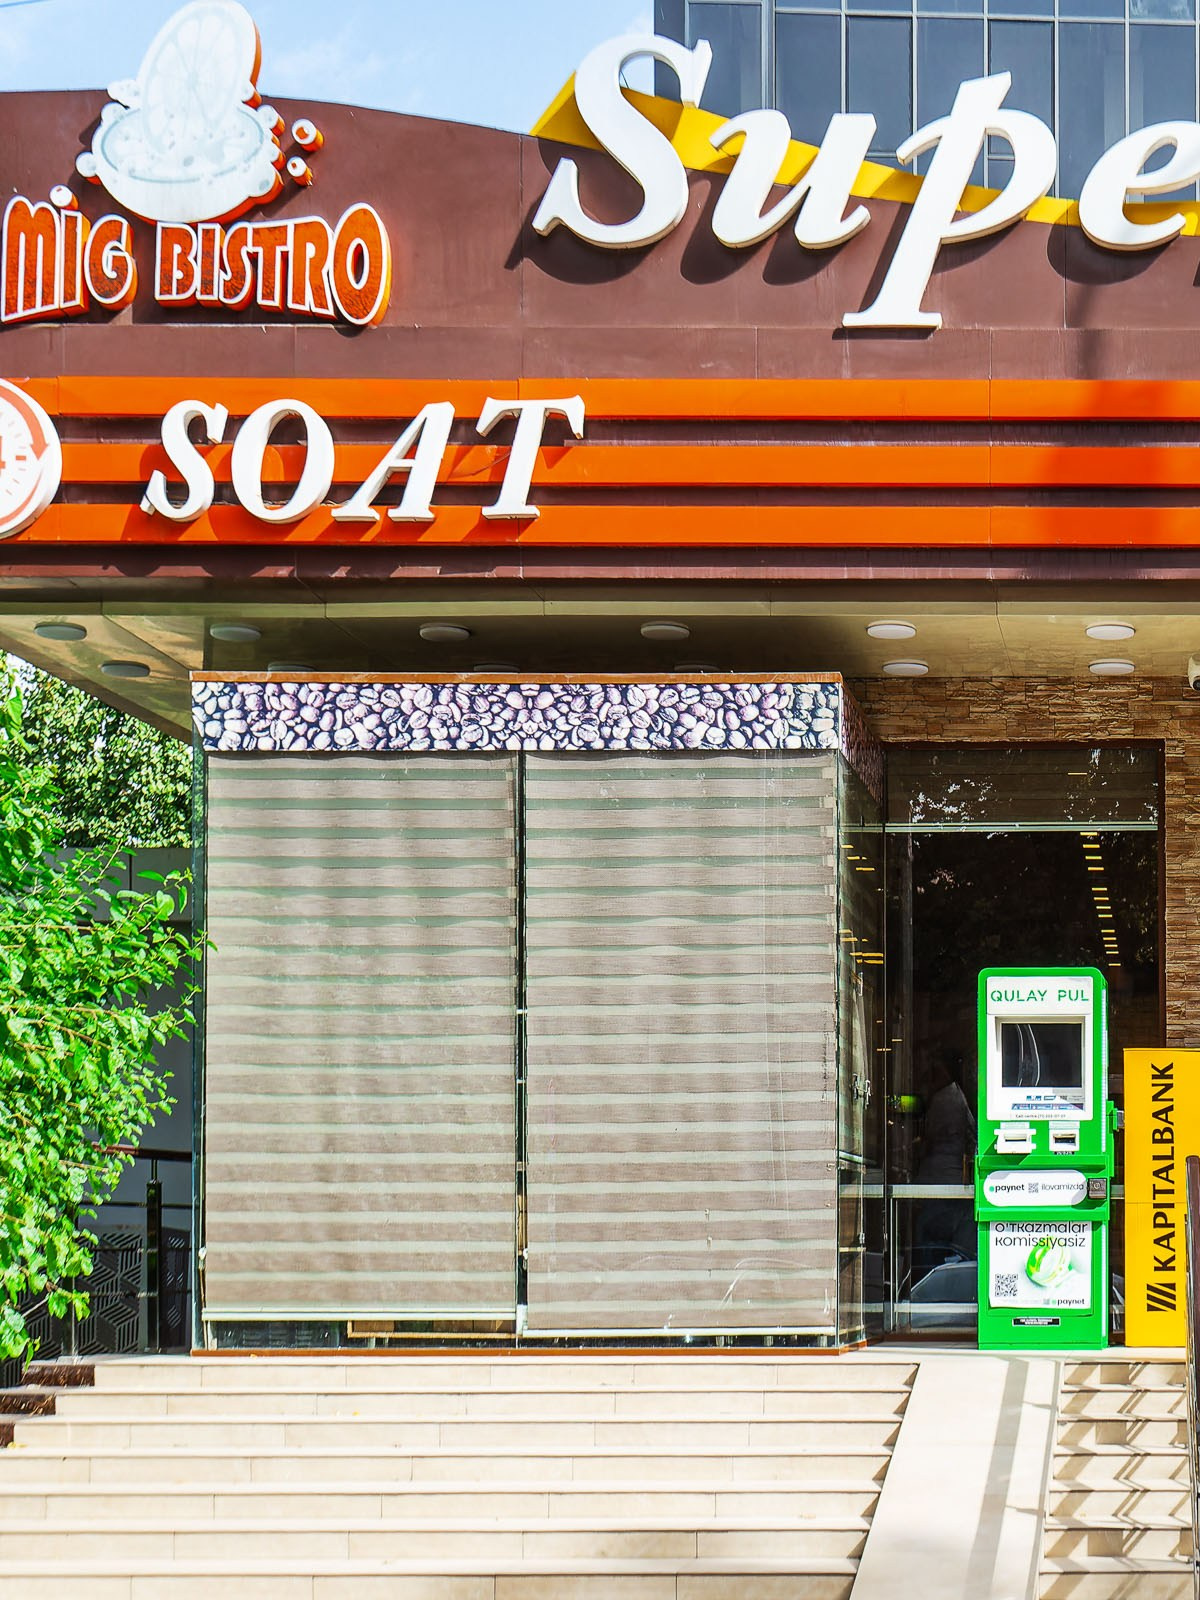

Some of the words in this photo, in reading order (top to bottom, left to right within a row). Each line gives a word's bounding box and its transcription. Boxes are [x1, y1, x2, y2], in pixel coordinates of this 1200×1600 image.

[154, 202, 392, 326] BISTRO
[139, 395, 585, 523] SOAT
[990, 989, 1047, 1002] QULAY
[1057, 989, 1089, 1002] PUL
[1150, 1062, 1177, 1272] KAPITALBANK
[995, 1184, 1025, 1193] paynet
[1041, 1183, 1084, 1191] ilovamizda
[995, 1234, 1086, 1250] komissiyasiz
[1057, 1298, 1085, 1306] paynet
